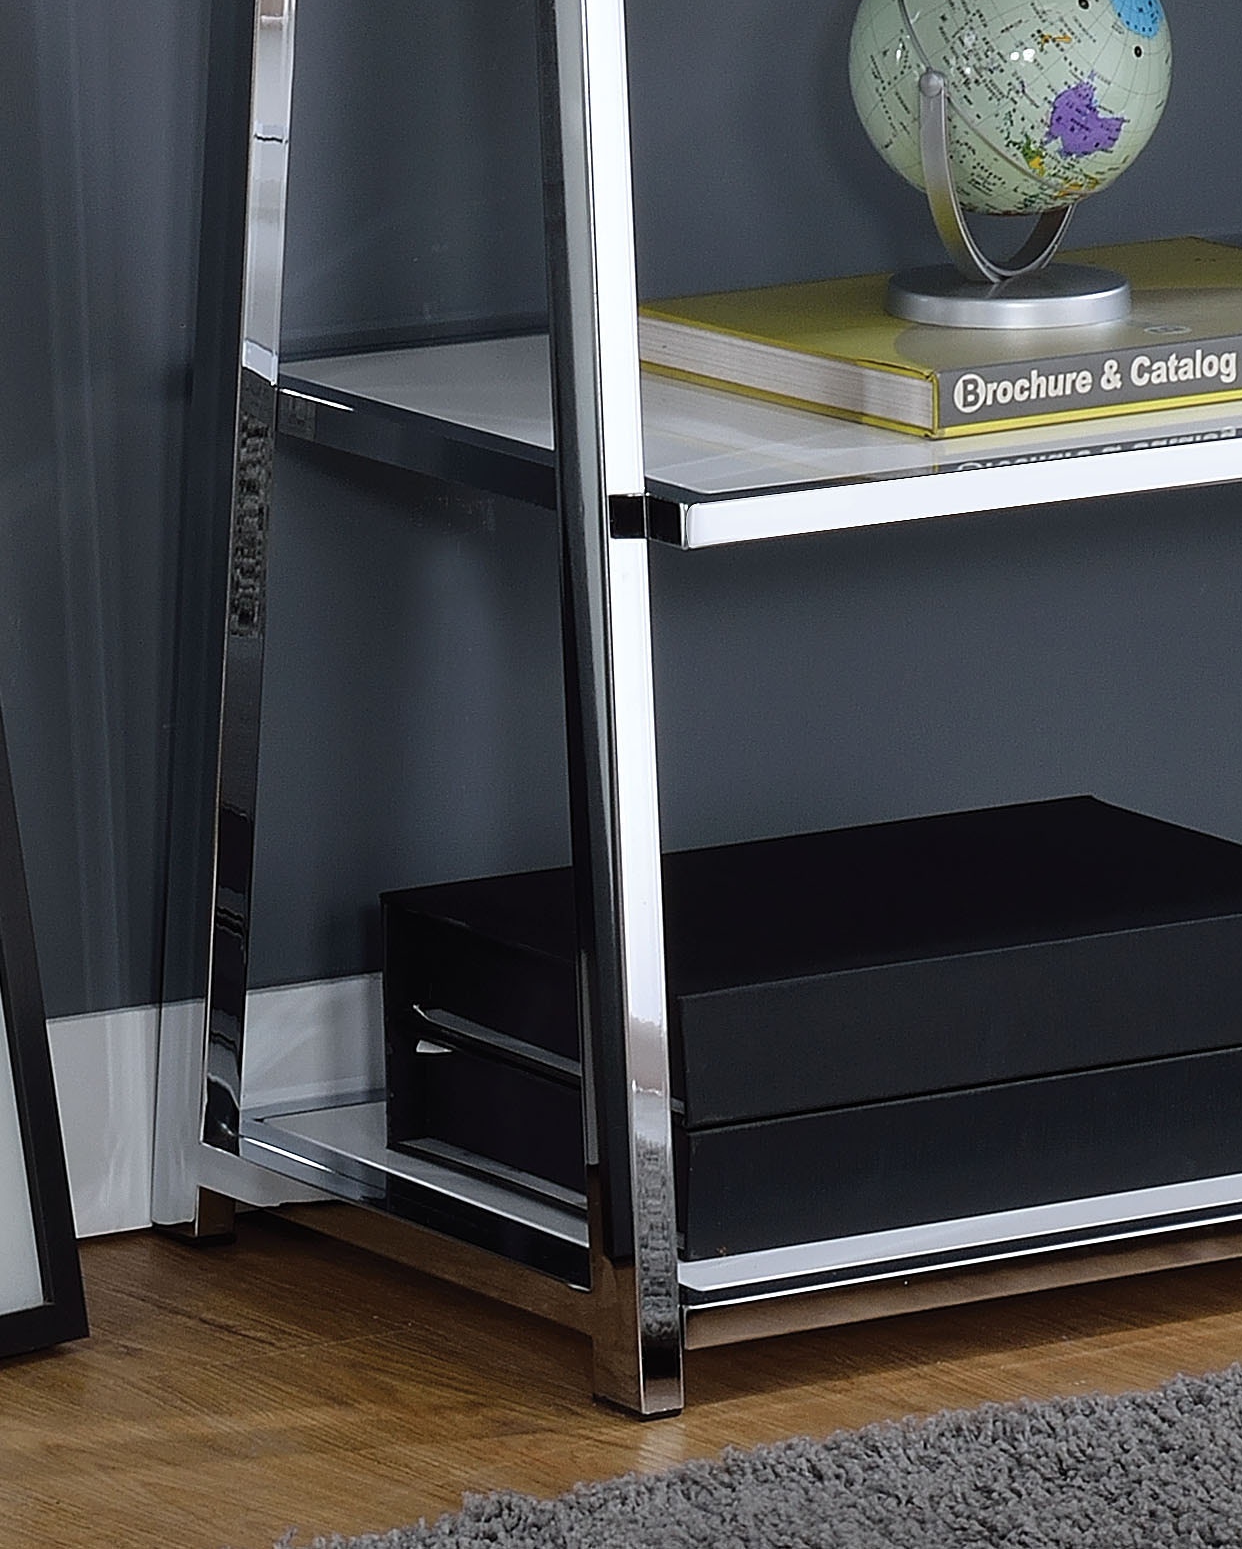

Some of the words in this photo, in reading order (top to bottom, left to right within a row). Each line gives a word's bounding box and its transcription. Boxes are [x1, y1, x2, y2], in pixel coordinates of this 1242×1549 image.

[953, 369, 1092, 414] Brochure
[1099, 359, 1123, 391] &
[1129, 349, 1238, 387] Catalog
